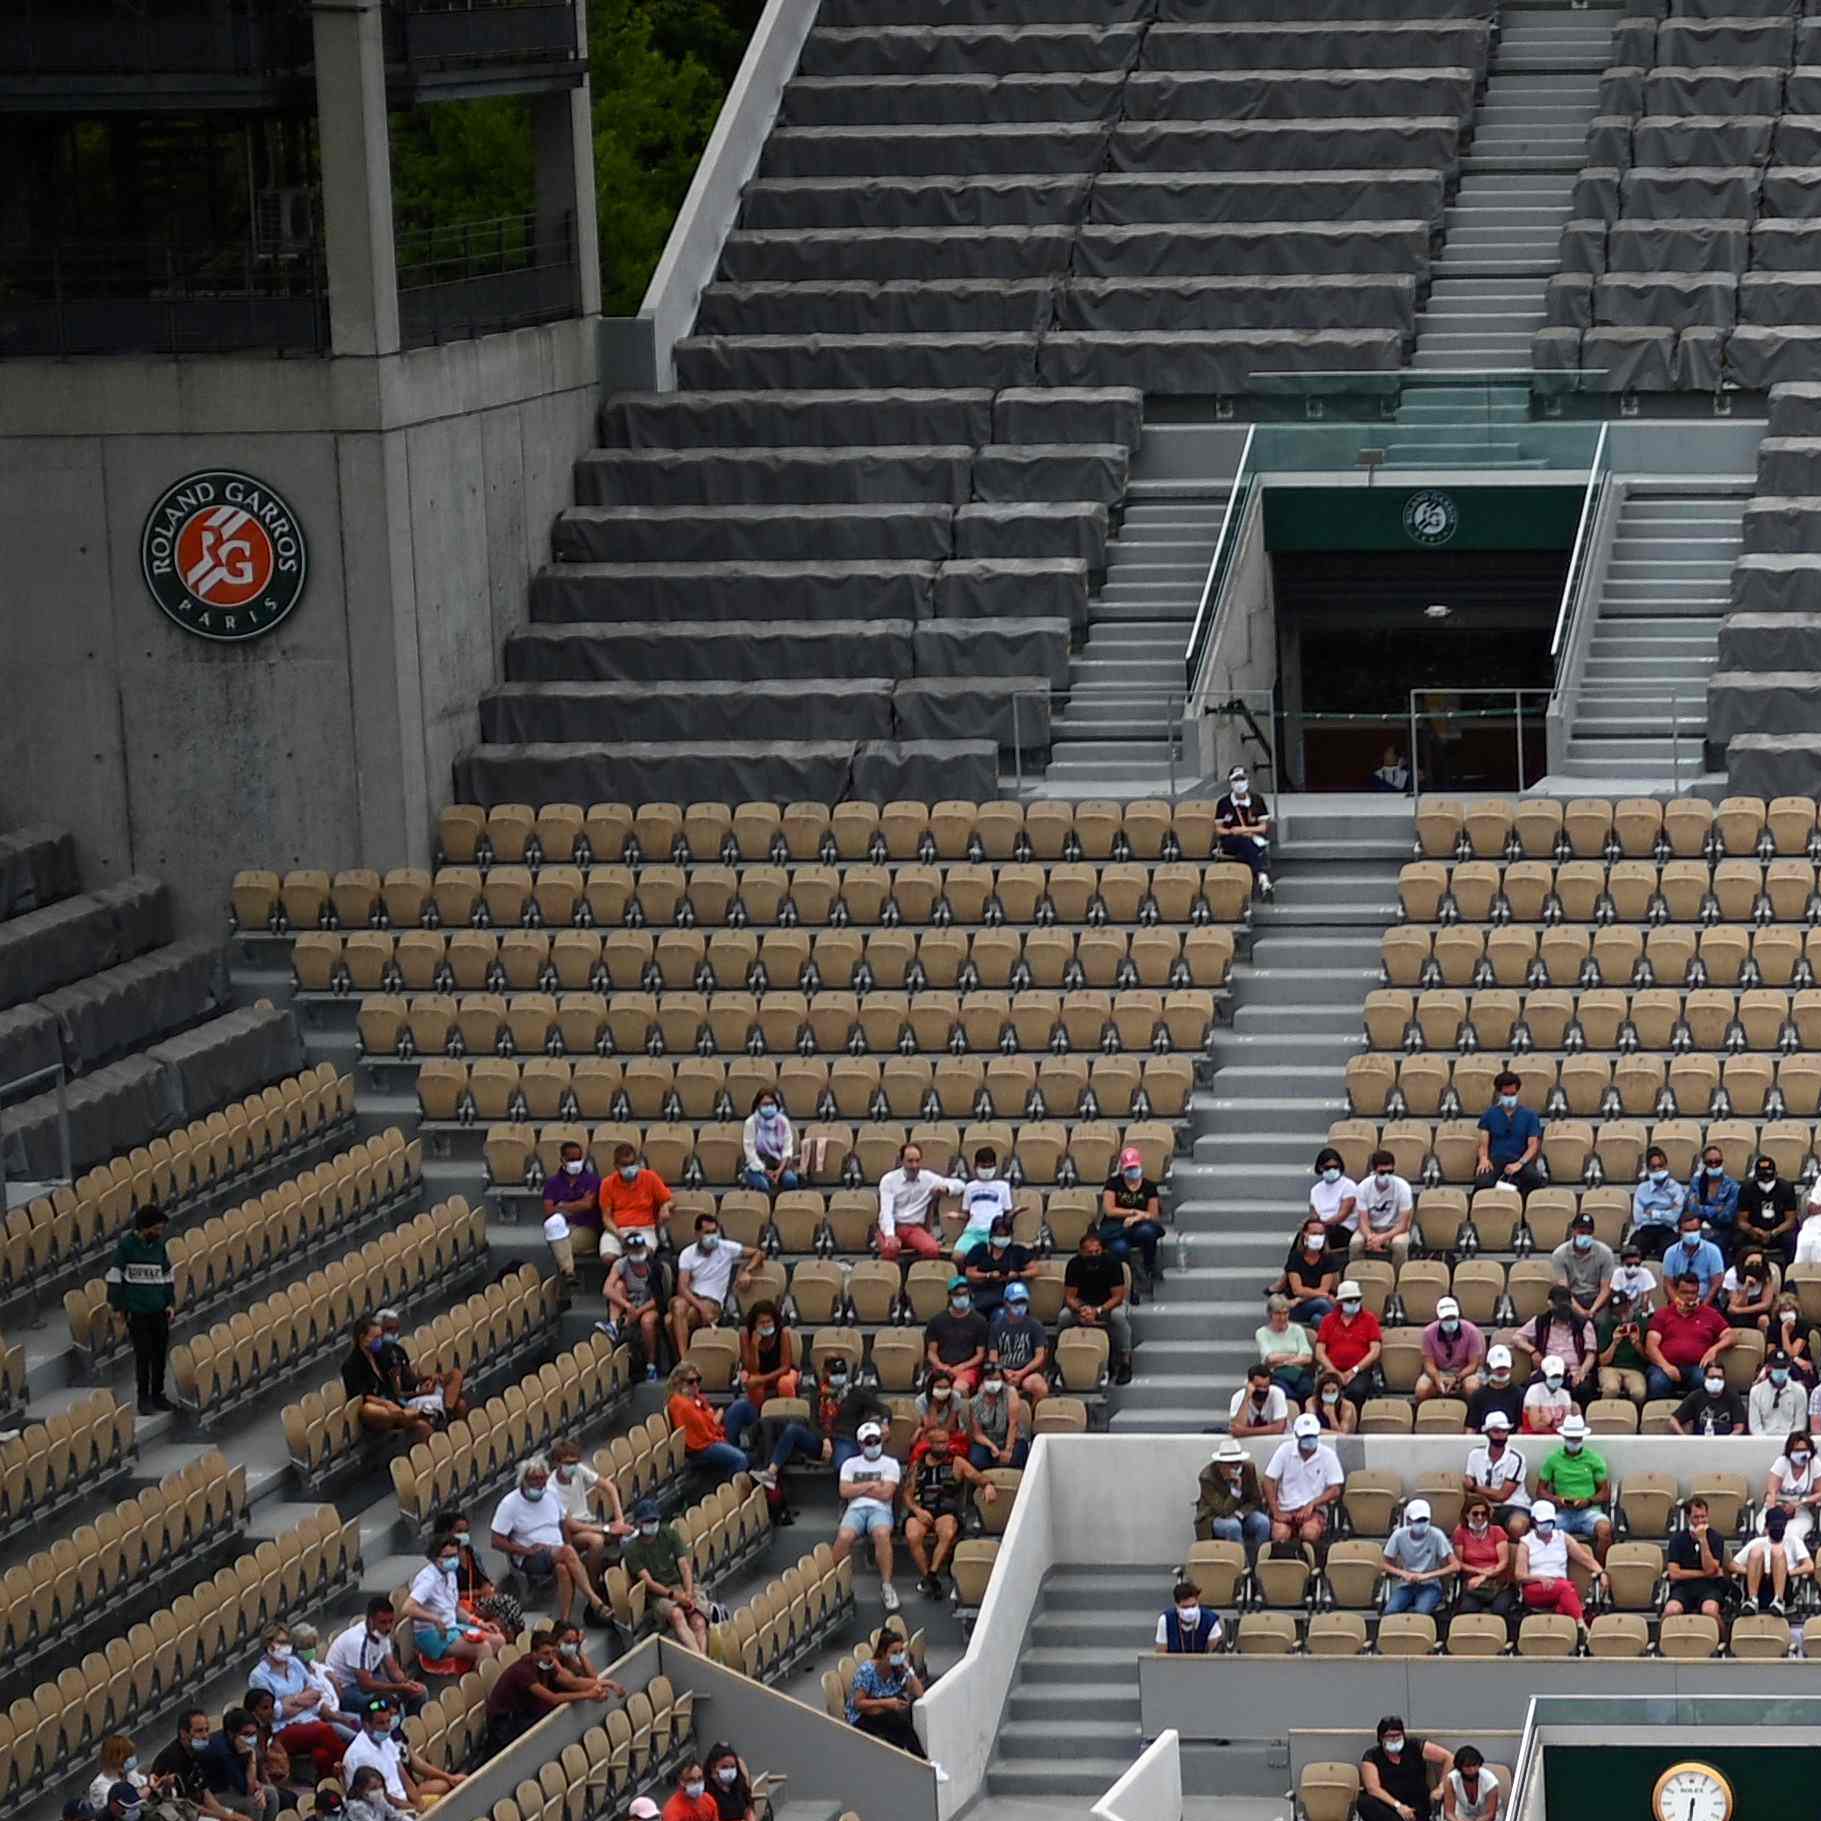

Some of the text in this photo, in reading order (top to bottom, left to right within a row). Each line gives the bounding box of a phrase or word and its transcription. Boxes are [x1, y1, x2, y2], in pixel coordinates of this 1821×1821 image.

[151, 482, 297, 575] ROLAND GARROS
[178, 597, 277, 629] PARIS
